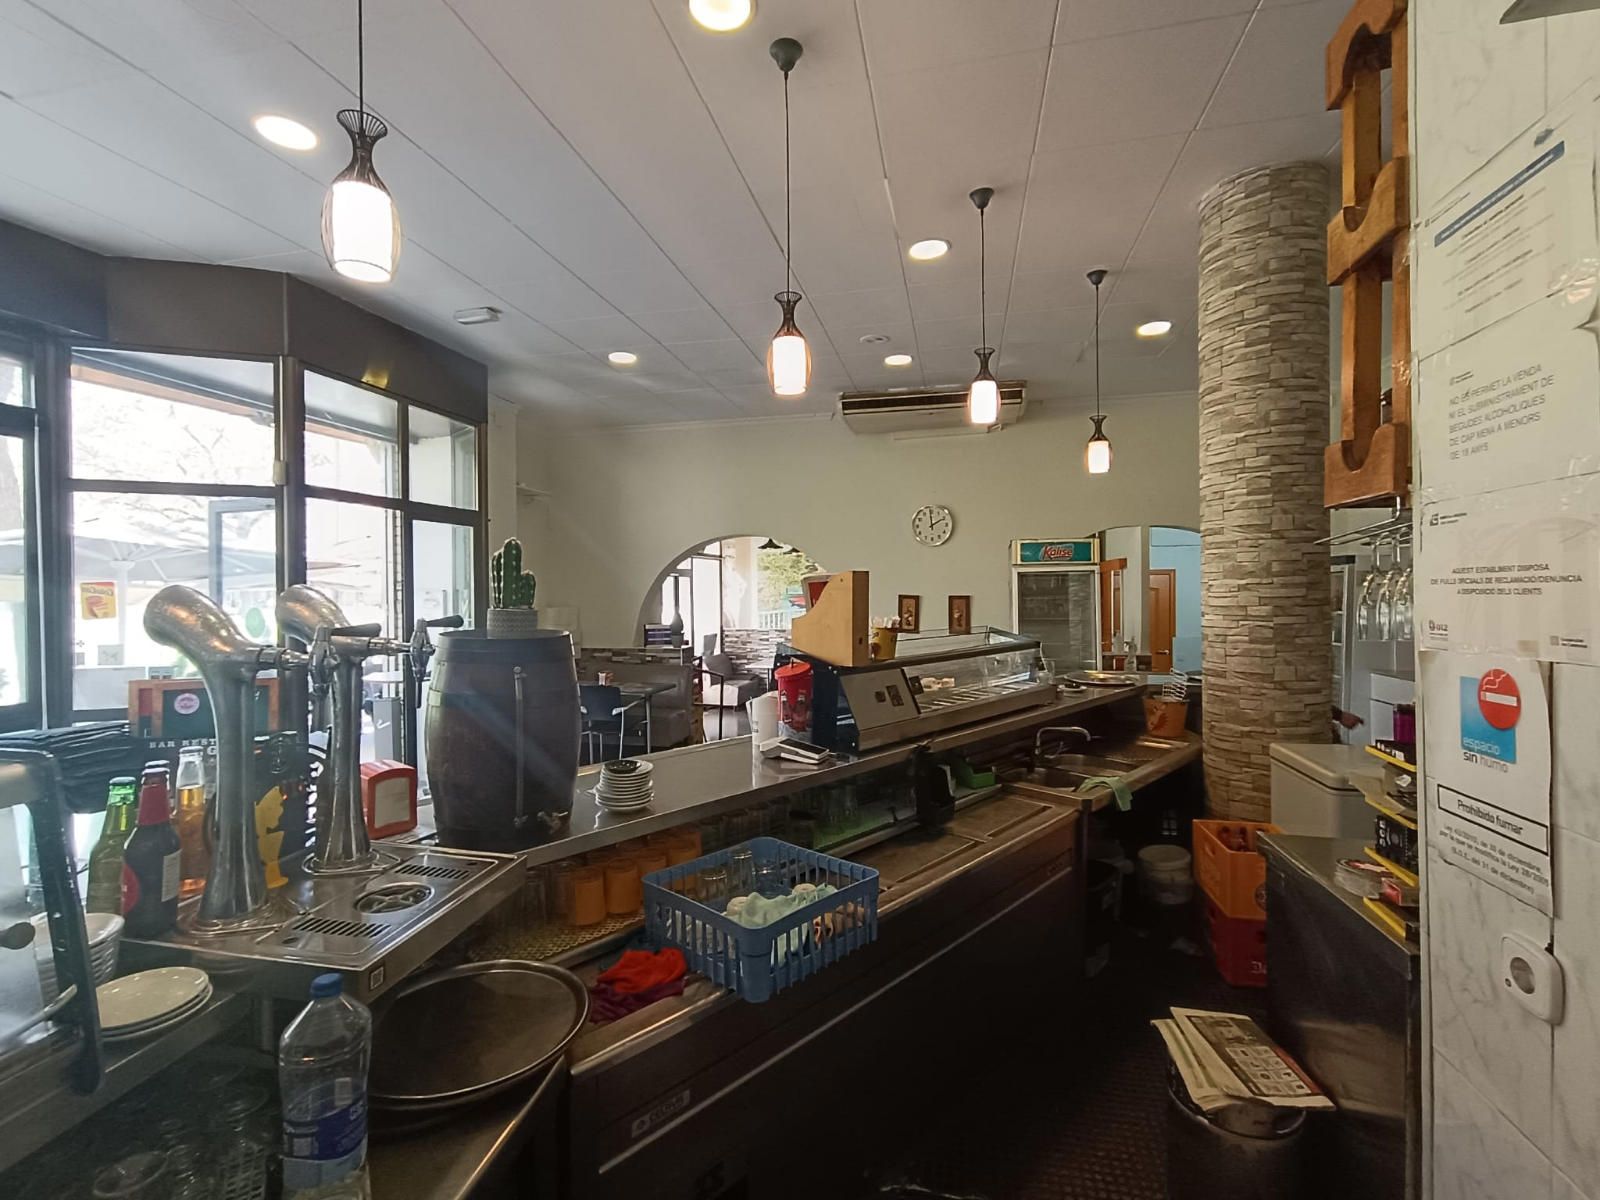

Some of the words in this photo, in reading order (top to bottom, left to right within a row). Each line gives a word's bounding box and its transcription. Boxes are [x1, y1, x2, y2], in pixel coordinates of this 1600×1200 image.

[1540, 374, 1554, 389] DE
[1449, 436, 1460, 447] DE
[149, 740, 176, 749] BAR
[1463, 737, 1500, 756] espacio
[1463, 751, 1478, 764] sin
[1457, 799, 1495, 824] Prohibido
[1495, 814, 1523, 836] fumar
